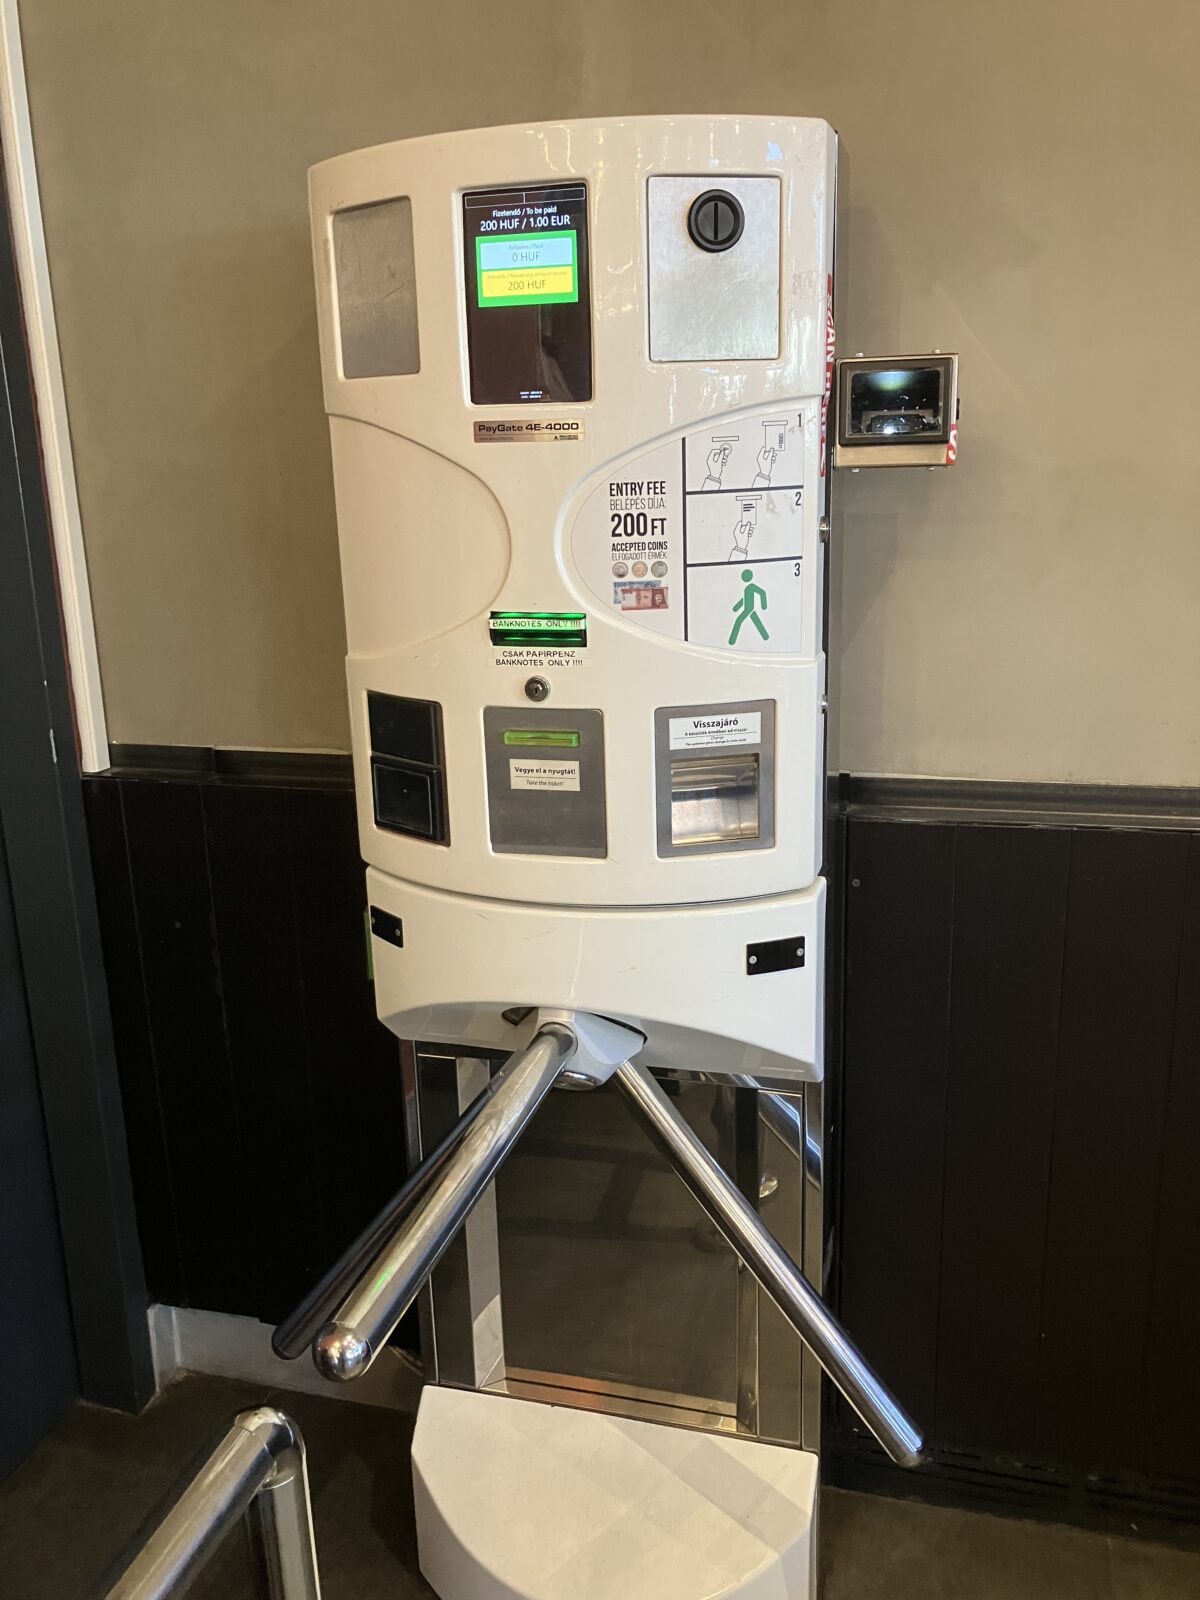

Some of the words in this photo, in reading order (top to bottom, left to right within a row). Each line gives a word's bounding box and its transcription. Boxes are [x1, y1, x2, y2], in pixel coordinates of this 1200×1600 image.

[535, 206, 542, 214] be
[543, 205, 557, 215] paid
[480, 220, 497, 231] 200
[500, 219, 520, 230] HUF
[521, 218, 527, 229] /
[529, 216, 549, 227] 1.00
[551, 215, 571, 226] EUR
[512, 253, 518, 262] 0
[520, 251, 541, 262] HUF
[507, 280, 525, 291] 200
[527, 279, 547, 289] HUF
[797, 413, 802, 428] 1
[478, 424, 524, 434] PayGate
[525, 422, 579, 431] 4E-4000
[609, 481, 645, 497] ENTRY
[647, 480, 667, 495] FEE
[795, 491, 802, 506] 2
[610, 512, 648, 537] 200
[650, 517, 667, 536] FT
[611, 541, 646, 552] ACCEPTED
[647, 540, 668, 551] COINS
[794, 562, 801, 577] 3
[492, 620, 542, 628] BANKNOTES
[545, 620, 568, 628] ONLY
[502, 650, 525, 658] CSAK
[495, 658, 543, 666] BANKNOTES
[693, 717, 738, 728] Visszajáró
[514, 766, 535, 775] Vegye
[548, 767, 576, 775] nyugtát!
